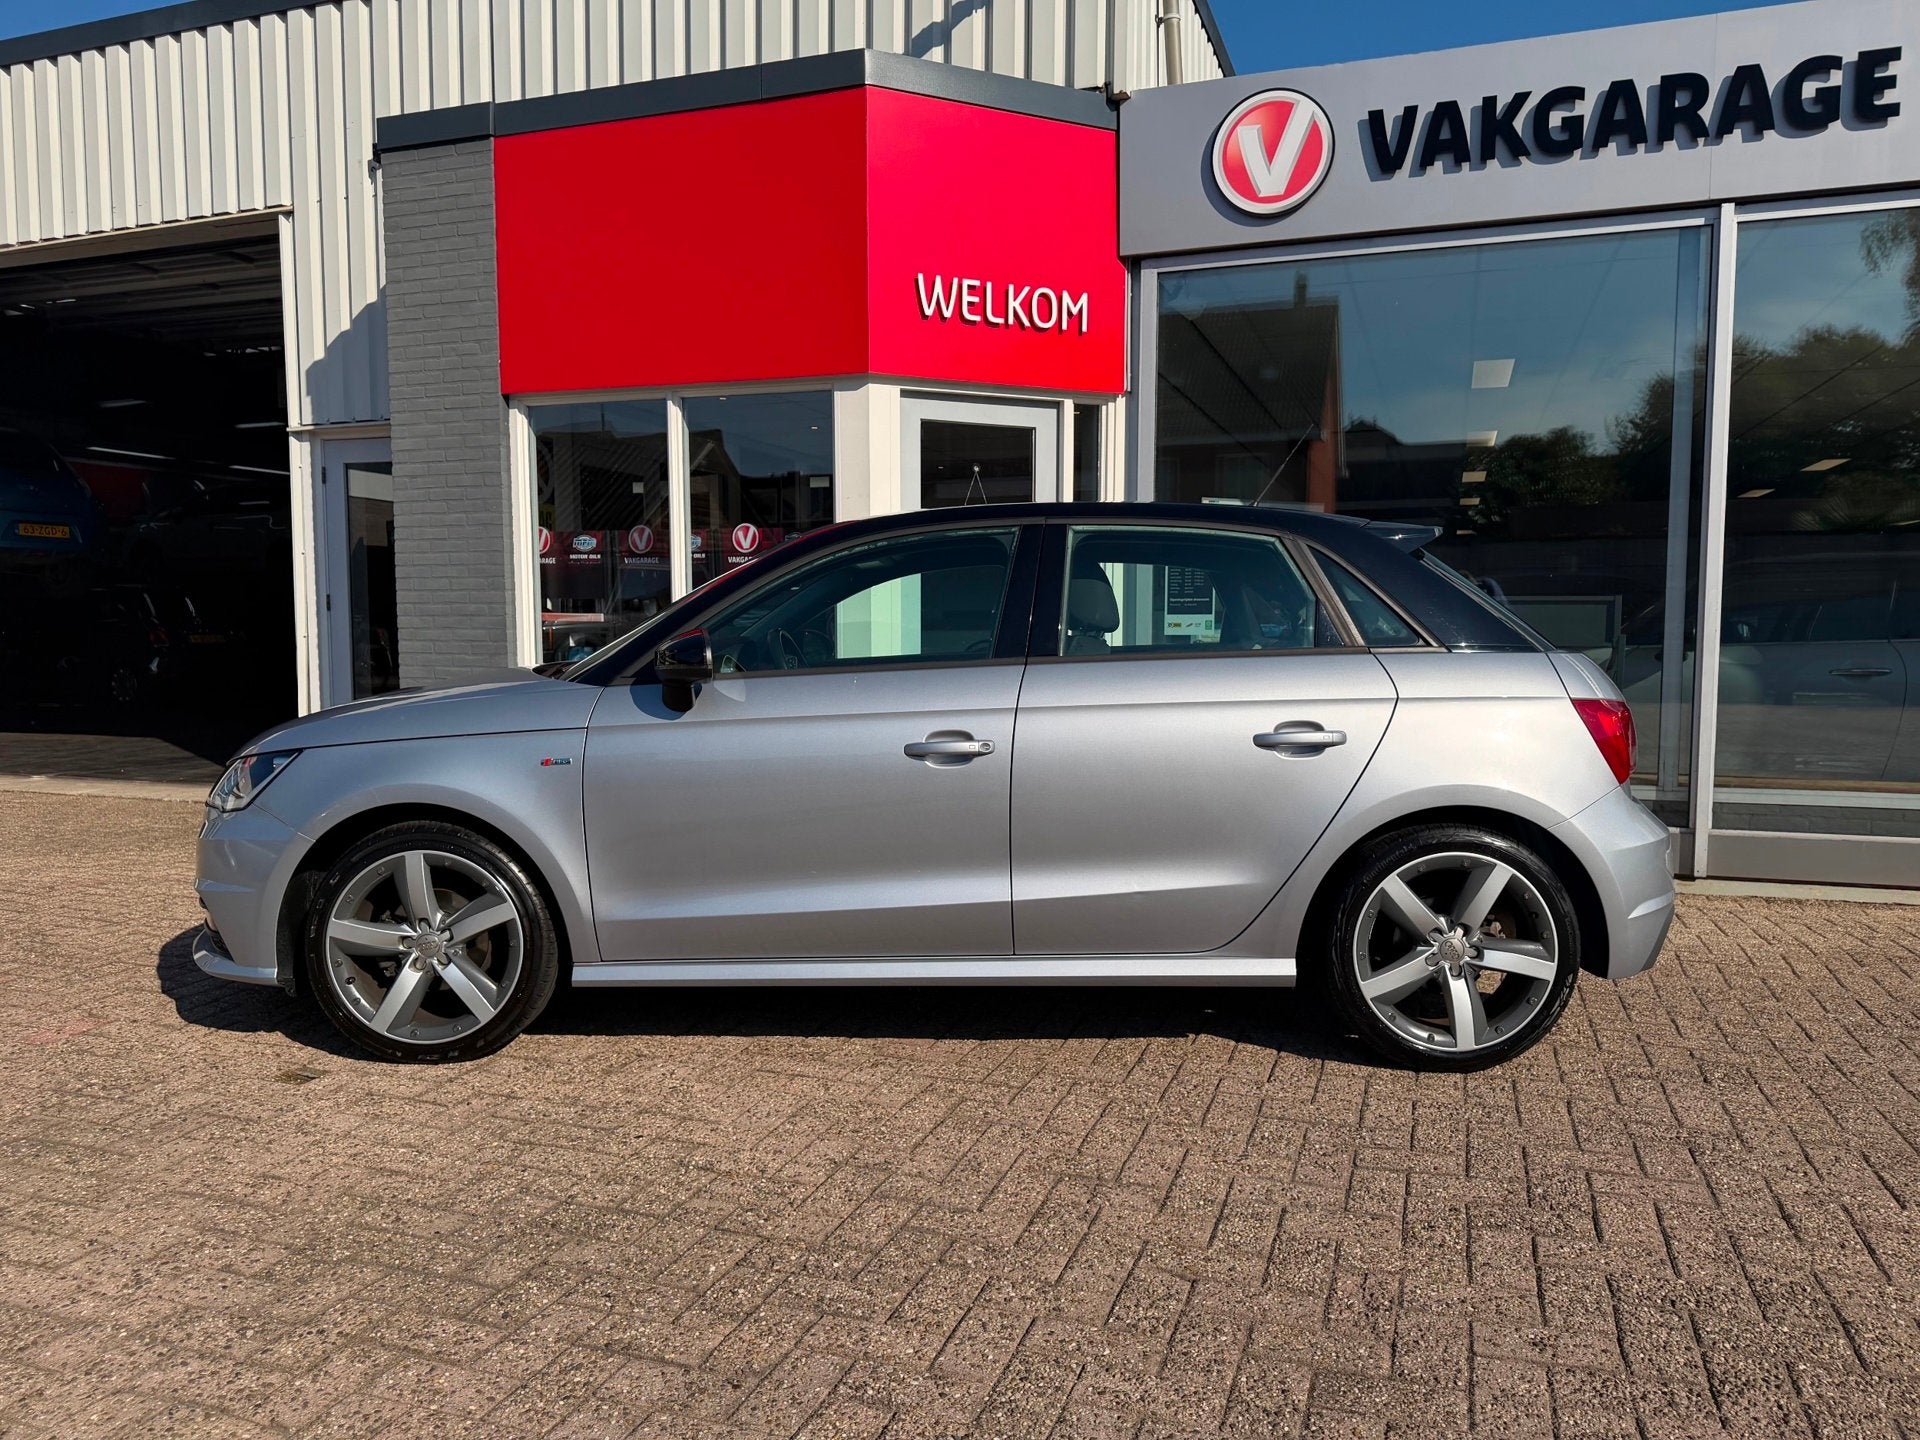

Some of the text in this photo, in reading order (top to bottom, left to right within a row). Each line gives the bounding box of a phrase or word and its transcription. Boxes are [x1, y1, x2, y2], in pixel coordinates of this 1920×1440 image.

[1367, 46, 1903, 174] VAKGARAGE
[1238, 102, 1317, 198] V
[917, 272, 1089, 333] WELKOM
[23, 525, 68, 537] 63-ZGD-6
[624, 556, 660, 564] VAKGARAGE
